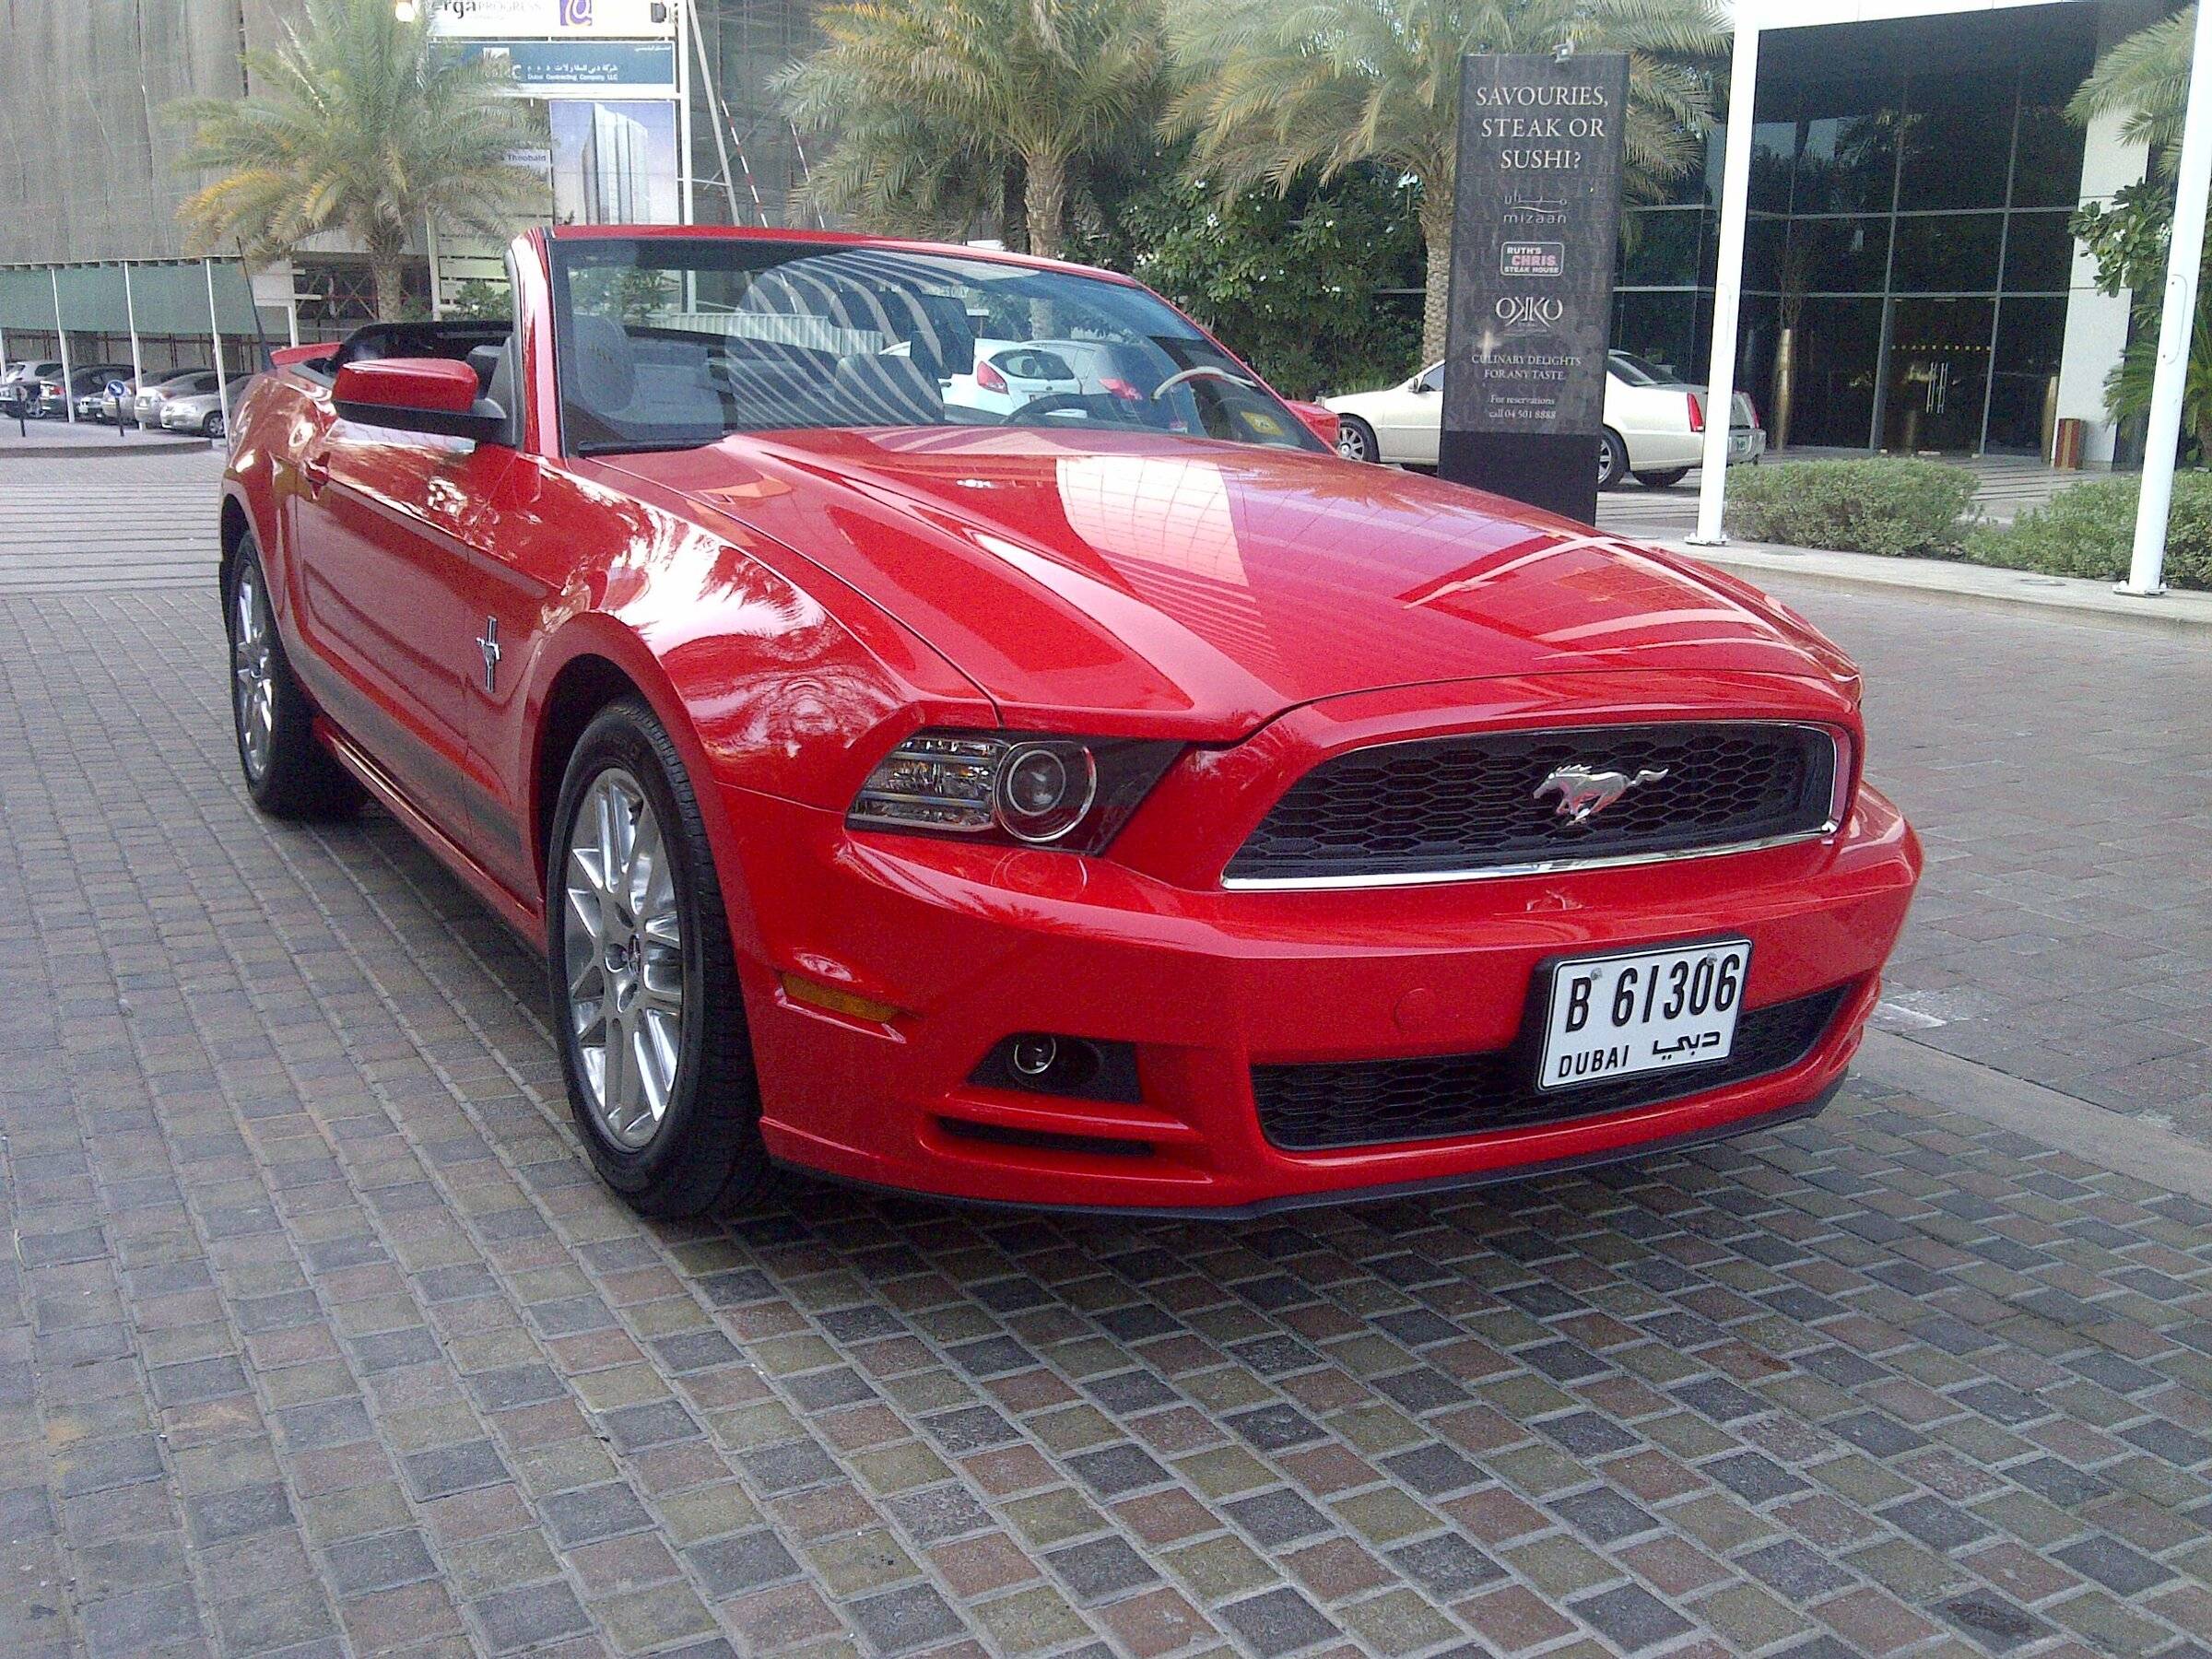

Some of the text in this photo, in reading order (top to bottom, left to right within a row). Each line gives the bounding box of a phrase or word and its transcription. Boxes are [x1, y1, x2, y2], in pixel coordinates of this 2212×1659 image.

[1475, 86, 1609, 108] SAVOURIES,
[1480, 117, 1606, 138] STEAK OR
[1500, 149, 1582, 170] SUSHI?
[1503, 213, 1567, 224] mizaan
[1506, 246, 1542, 254] RUTH'S
[1512, 254, 1557, 266] CHRIS
[1504, 265, 1559, 275] STEAK HOUSE
[1471, 354, 1583, 367] CULINARY DELIGHTS
[1484, 369, 1505, 379] FOR
[1506, 370, 1529, 379] ANY
[1490, 394, 1555, 406] For reservations
[1488, 408, 1503, 418] call
[1504, 408, 1516, 418] 04
[1565, 953, 1741, 1034] B 61306
[1652, 1030, 1721, 1061] دبي
[1558, 1044, 1630, 1078] DUBAI
